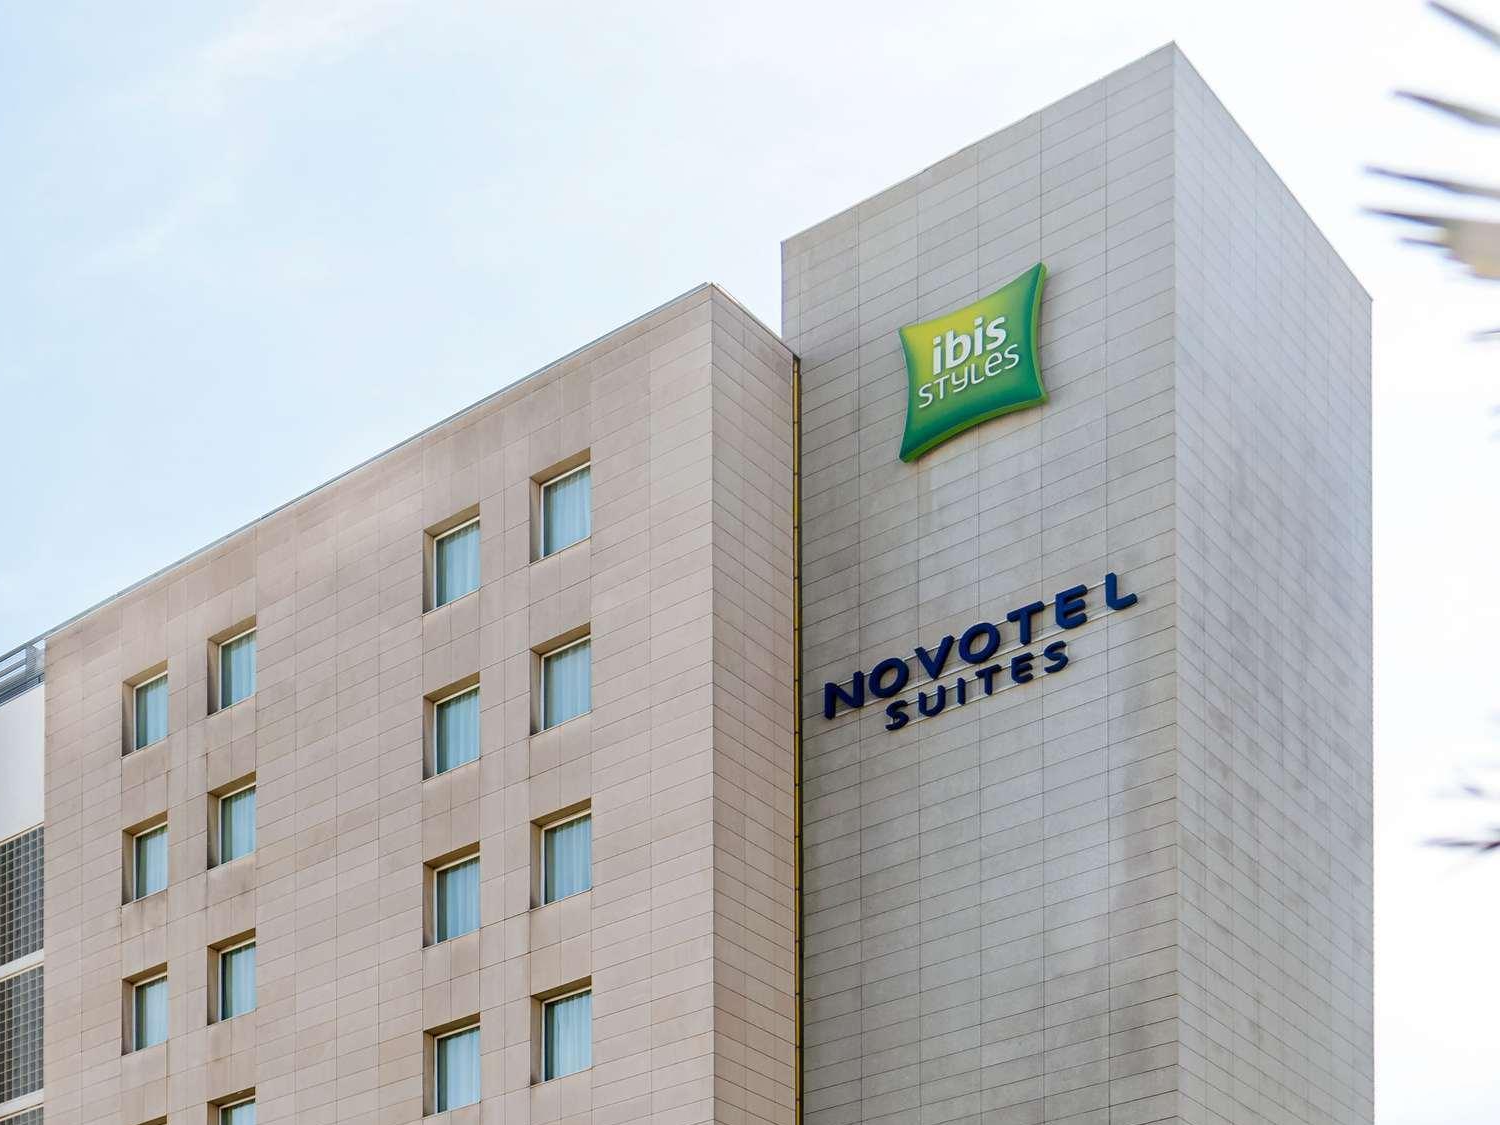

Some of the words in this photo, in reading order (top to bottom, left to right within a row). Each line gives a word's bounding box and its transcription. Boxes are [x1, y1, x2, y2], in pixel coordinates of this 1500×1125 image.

[932, 316, 1008, 376] ibis
[824, 572, 1138, 720] NOVOTEL
[885, 640, 1069, 730] SUITES
